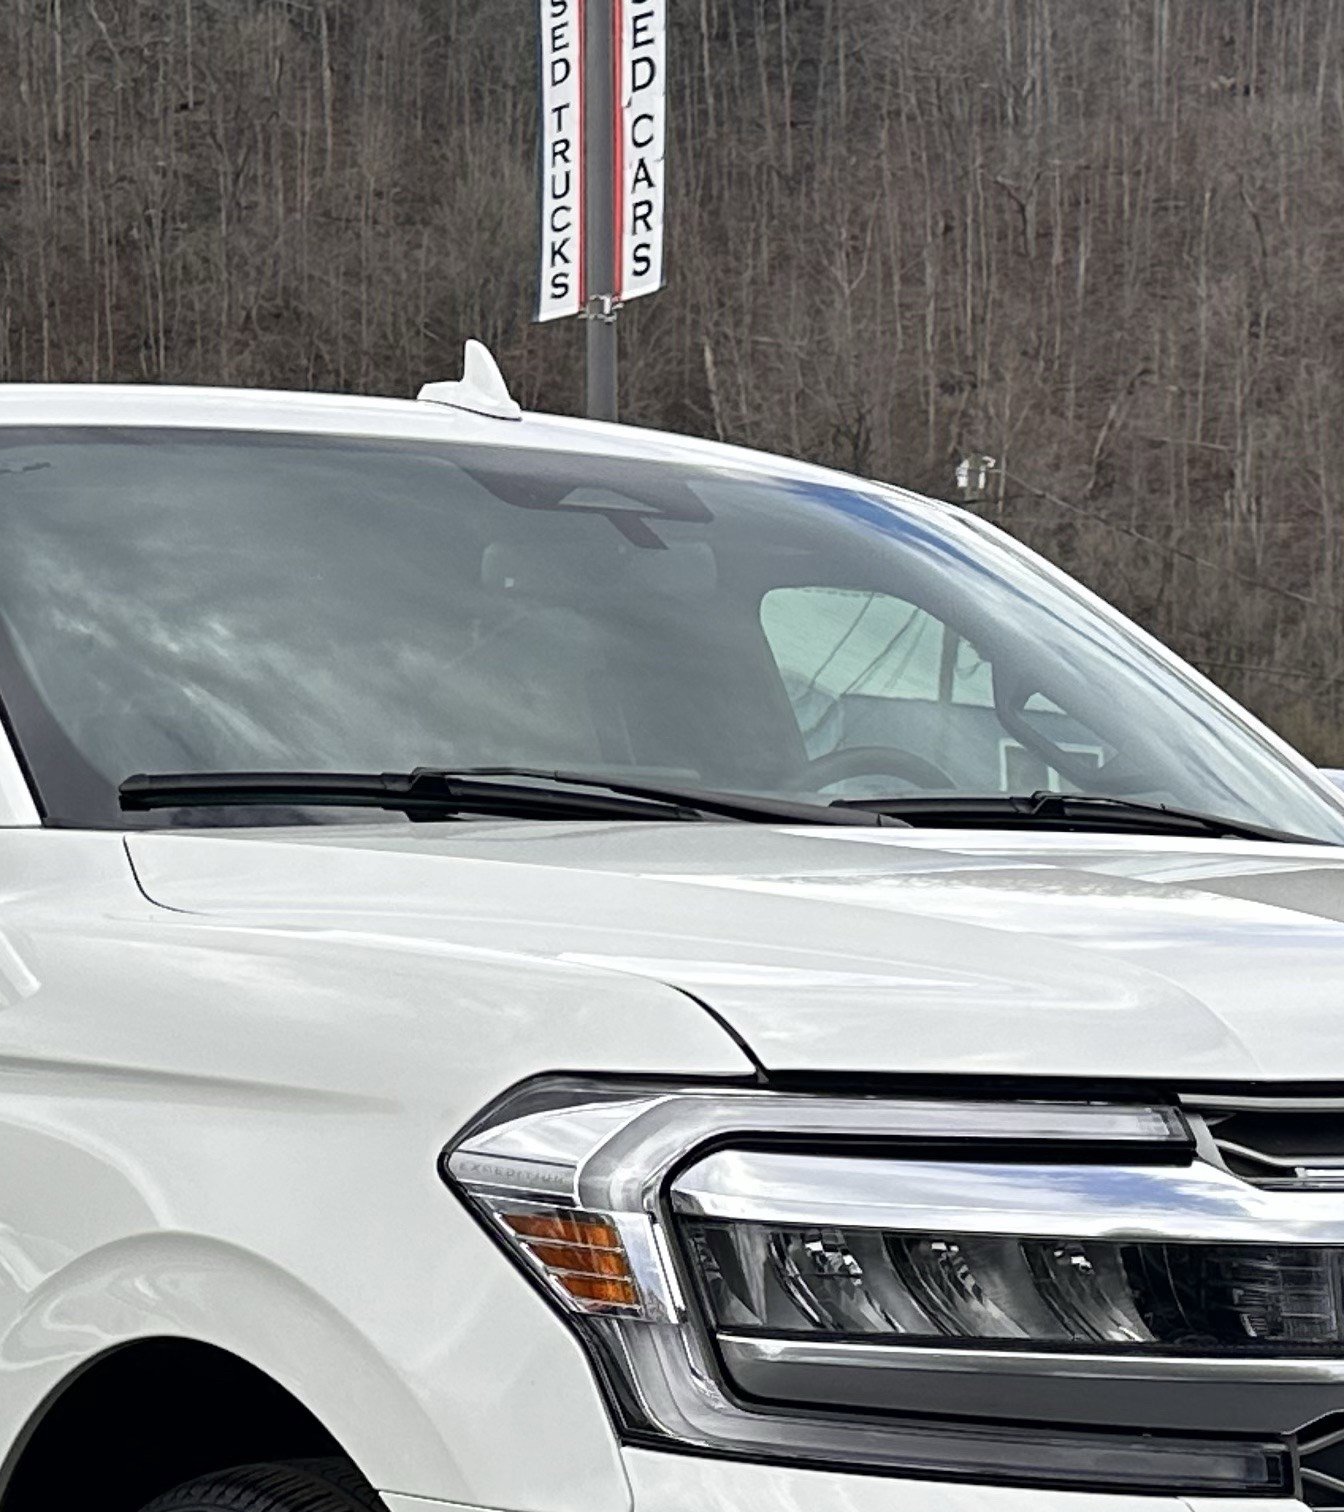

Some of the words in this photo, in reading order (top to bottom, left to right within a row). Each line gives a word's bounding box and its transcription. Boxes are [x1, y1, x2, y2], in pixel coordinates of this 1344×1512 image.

[631, 0, 657, 93] ED
[550, 103, 573, 299] TRUCKS
[630, 113, 656, 278] CARS
